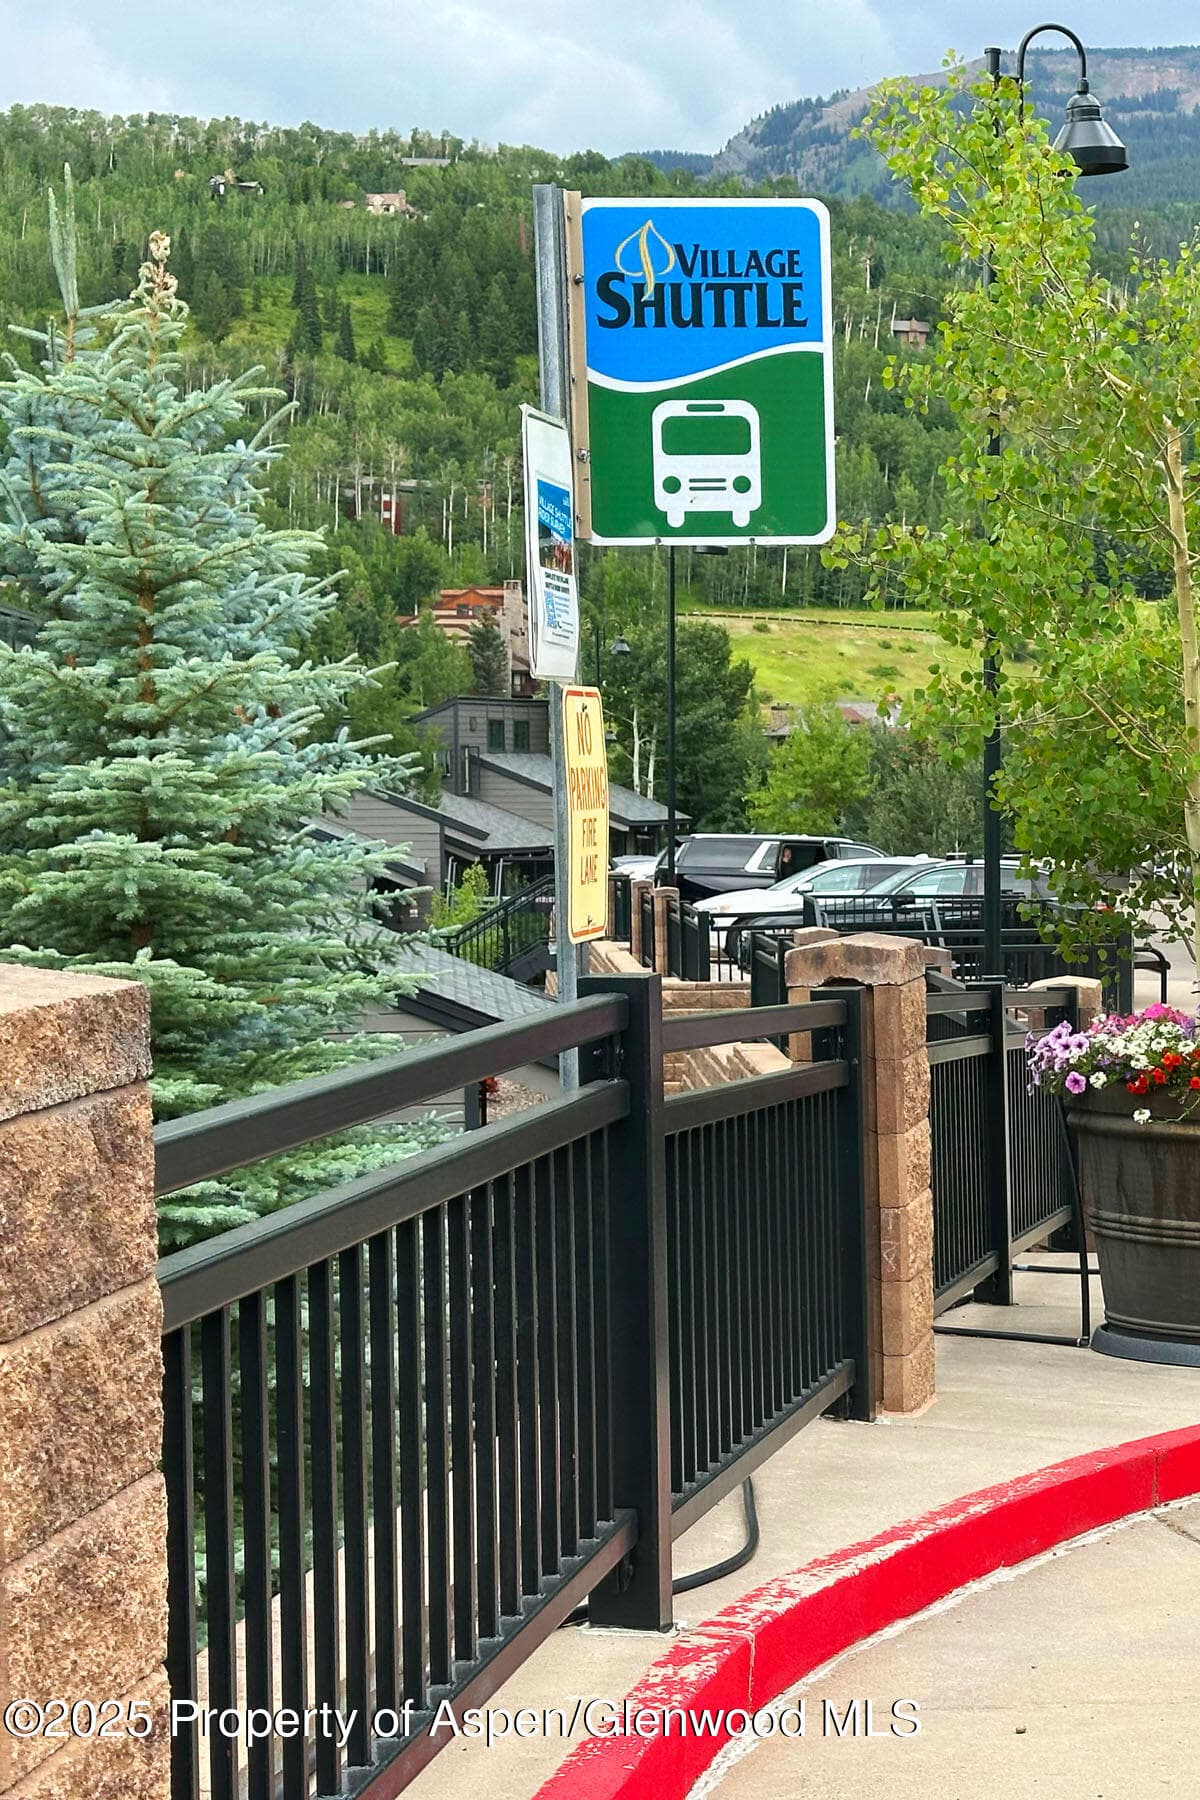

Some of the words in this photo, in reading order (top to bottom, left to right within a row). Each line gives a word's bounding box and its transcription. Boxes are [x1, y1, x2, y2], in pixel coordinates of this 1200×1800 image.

[673, 243, 803, 279] VILLAGE
[596, 271, 809, 329] SHUTTLE
[576, 711, 593, 756] NO
[570, 767, 606, 810] PARKING
[582, 818, 597, 848] FIRE
[580, 854, 598, 886] LANE
